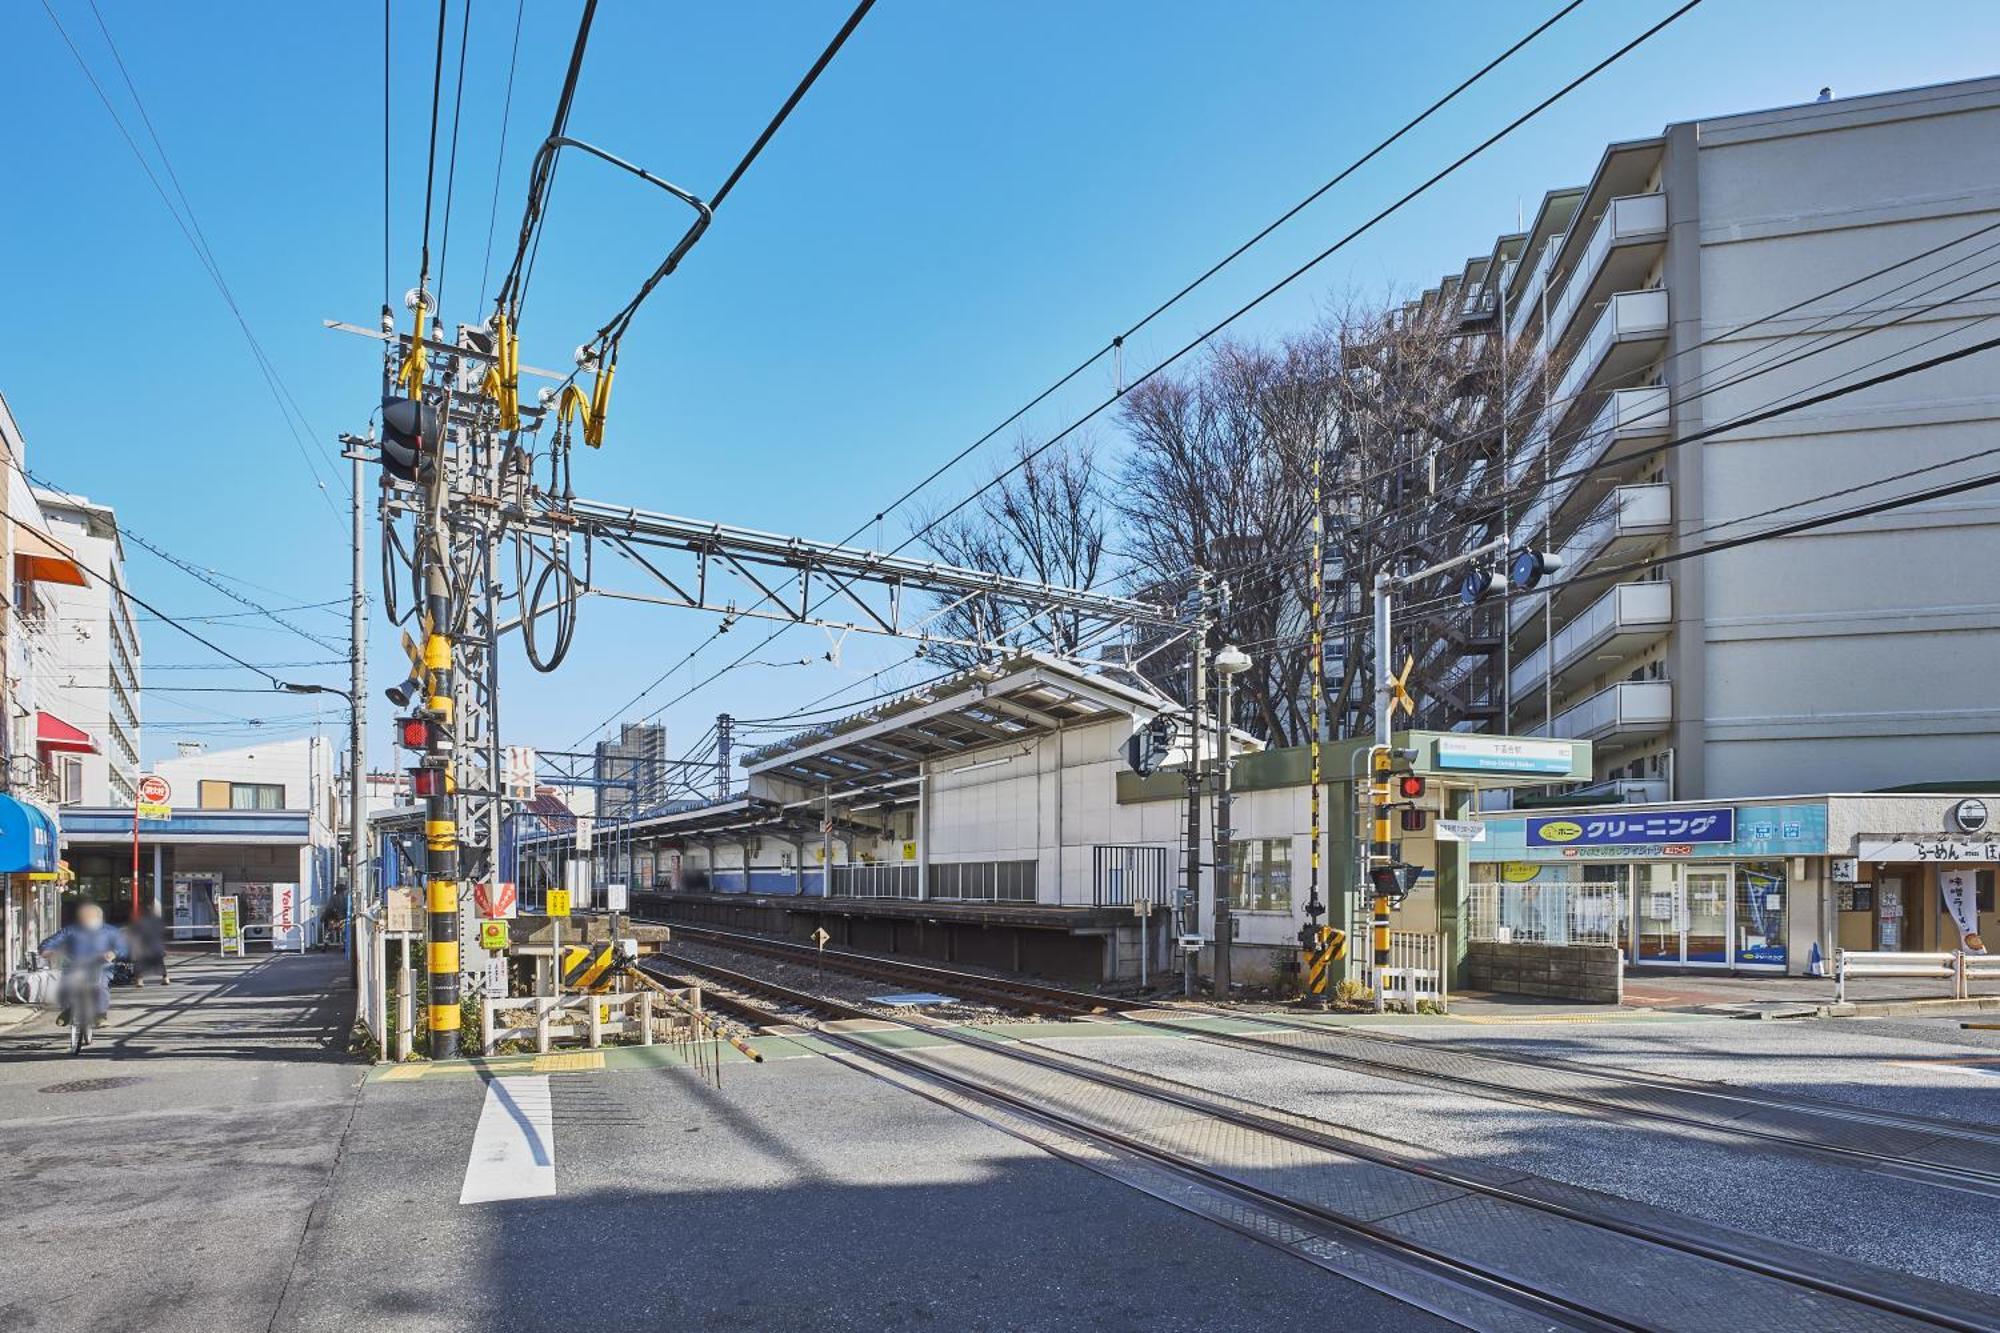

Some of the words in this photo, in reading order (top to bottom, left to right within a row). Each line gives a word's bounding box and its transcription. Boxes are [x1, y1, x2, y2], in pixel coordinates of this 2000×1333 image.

[1587, 815, 1717, 838] クリーニング
[1918, 843, 1960, 861] らーめん
[1985, 844, 2000, 860] ほ
[282, 888, 292, 934] Yakult
[1949, 876, 1970, 932] 味噌ラーメン
